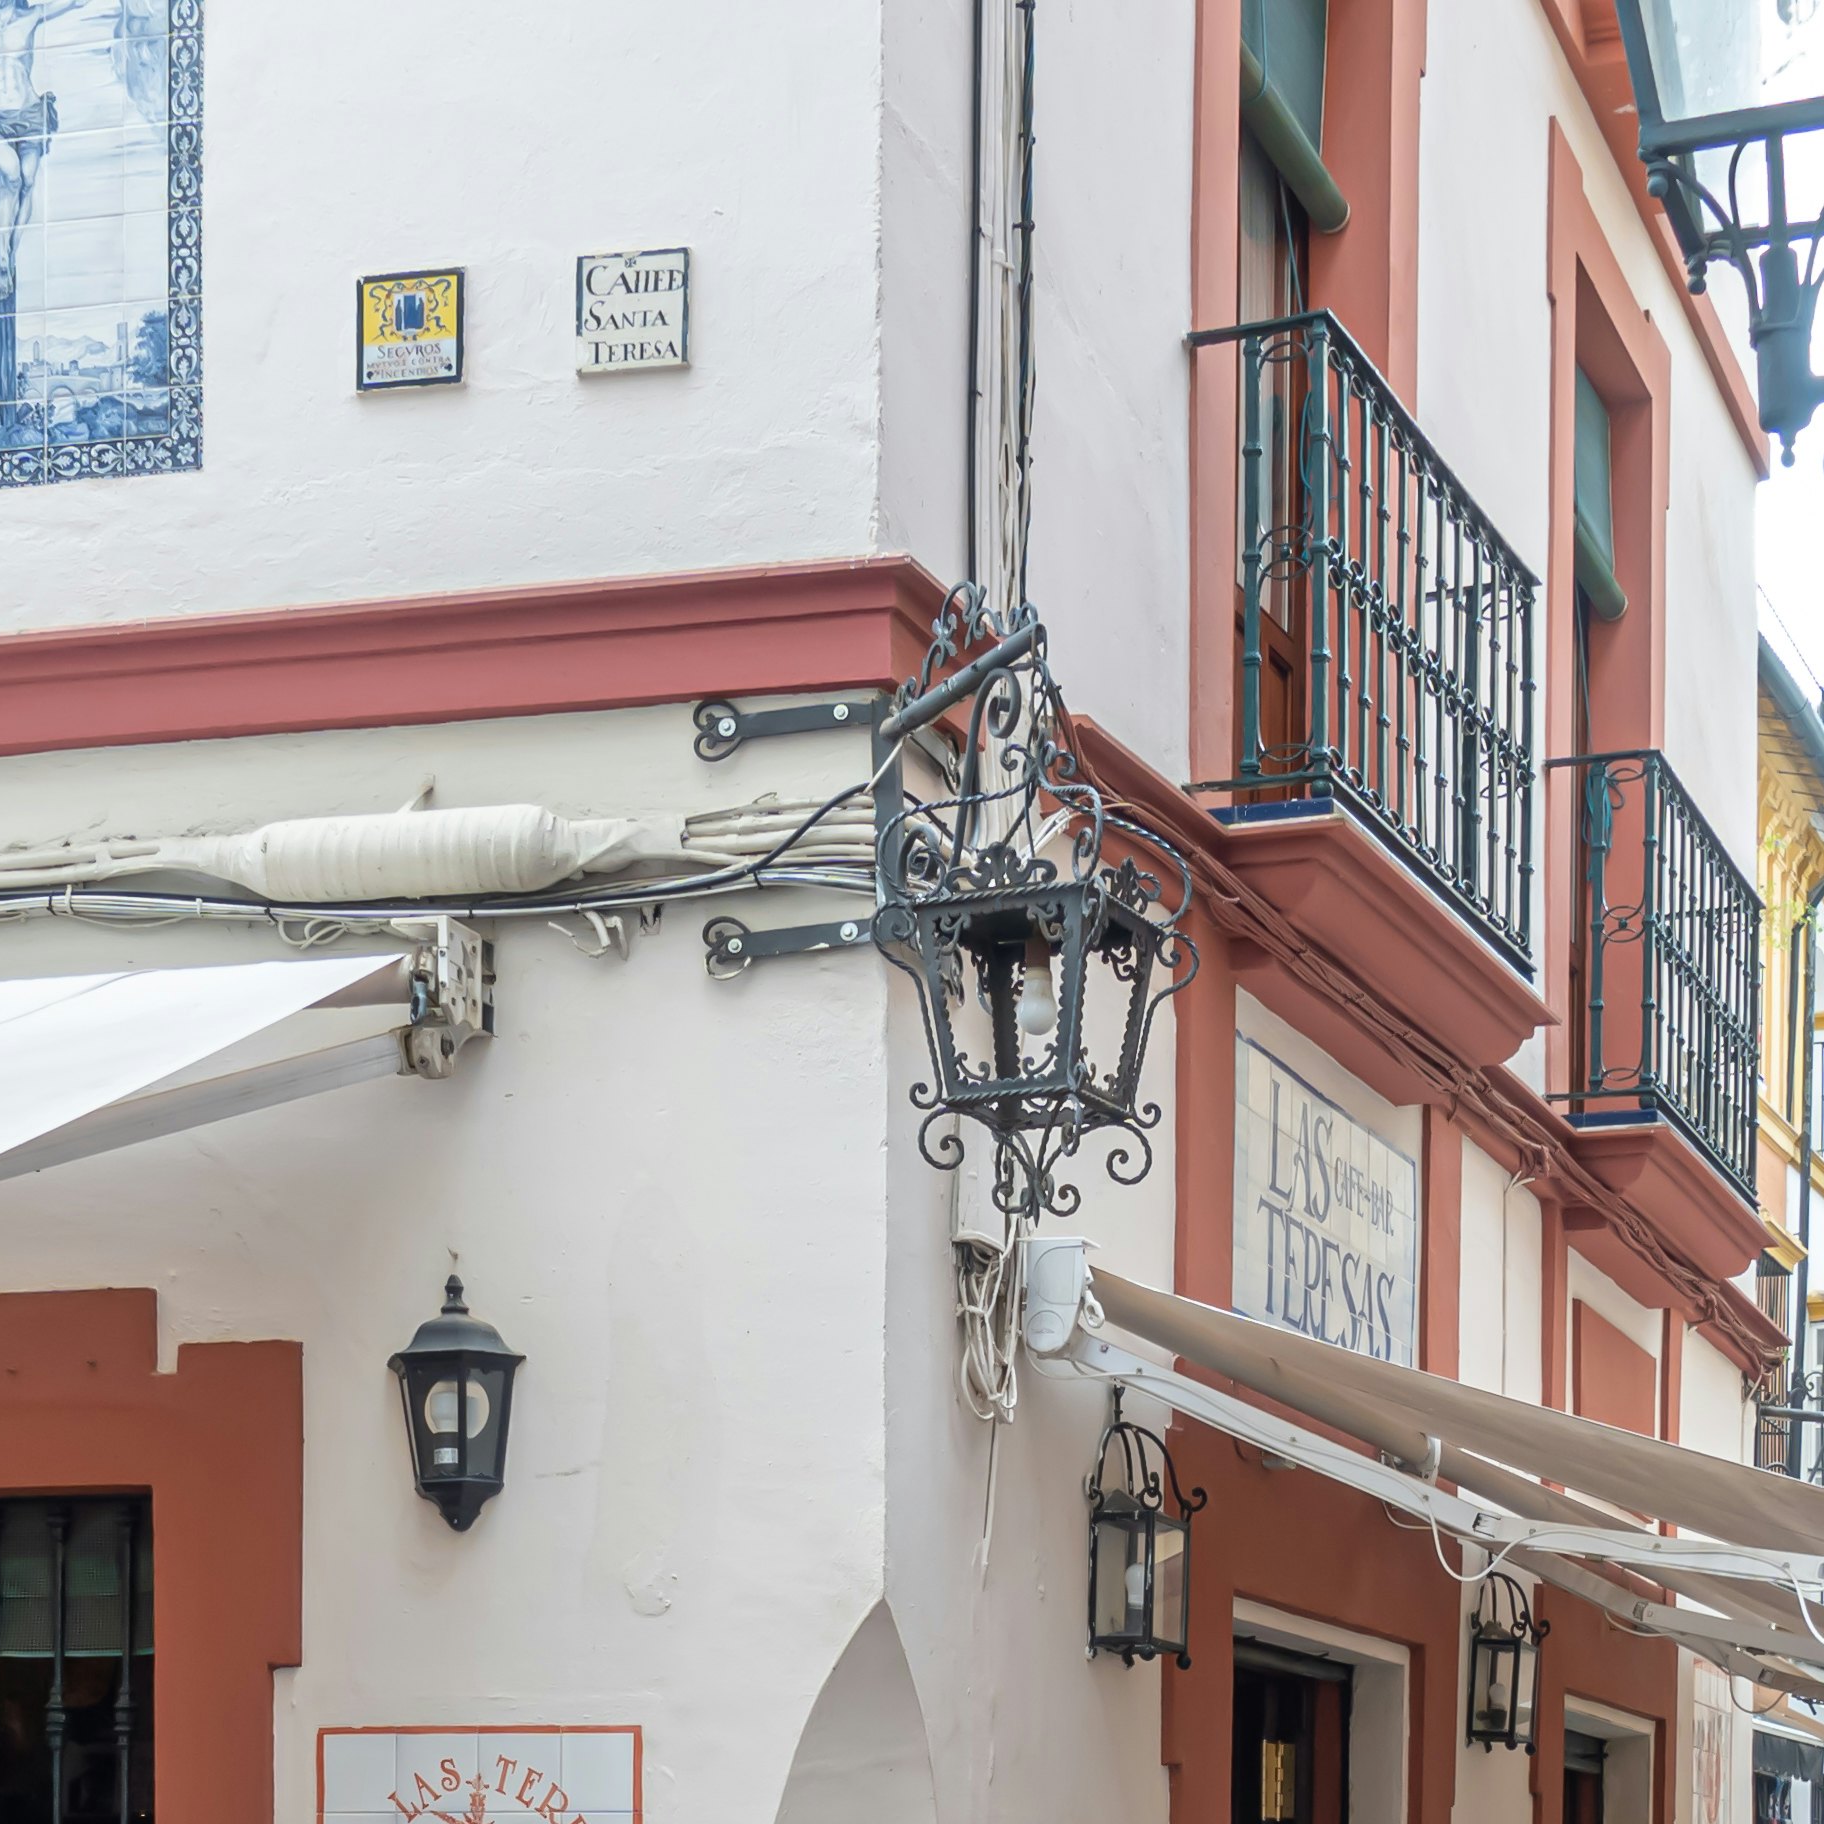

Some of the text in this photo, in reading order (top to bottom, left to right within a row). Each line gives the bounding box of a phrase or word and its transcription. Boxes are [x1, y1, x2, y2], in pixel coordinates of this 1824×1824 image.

[584, 300, 670, 332] SANTA
[589, 340, 680, 365] TERESA
[1270, 1079, 1333, 1224] LAS
[1257, 1194, 1395, 1361] TERESAS
[387, 1758, 461, 1823] LAS
